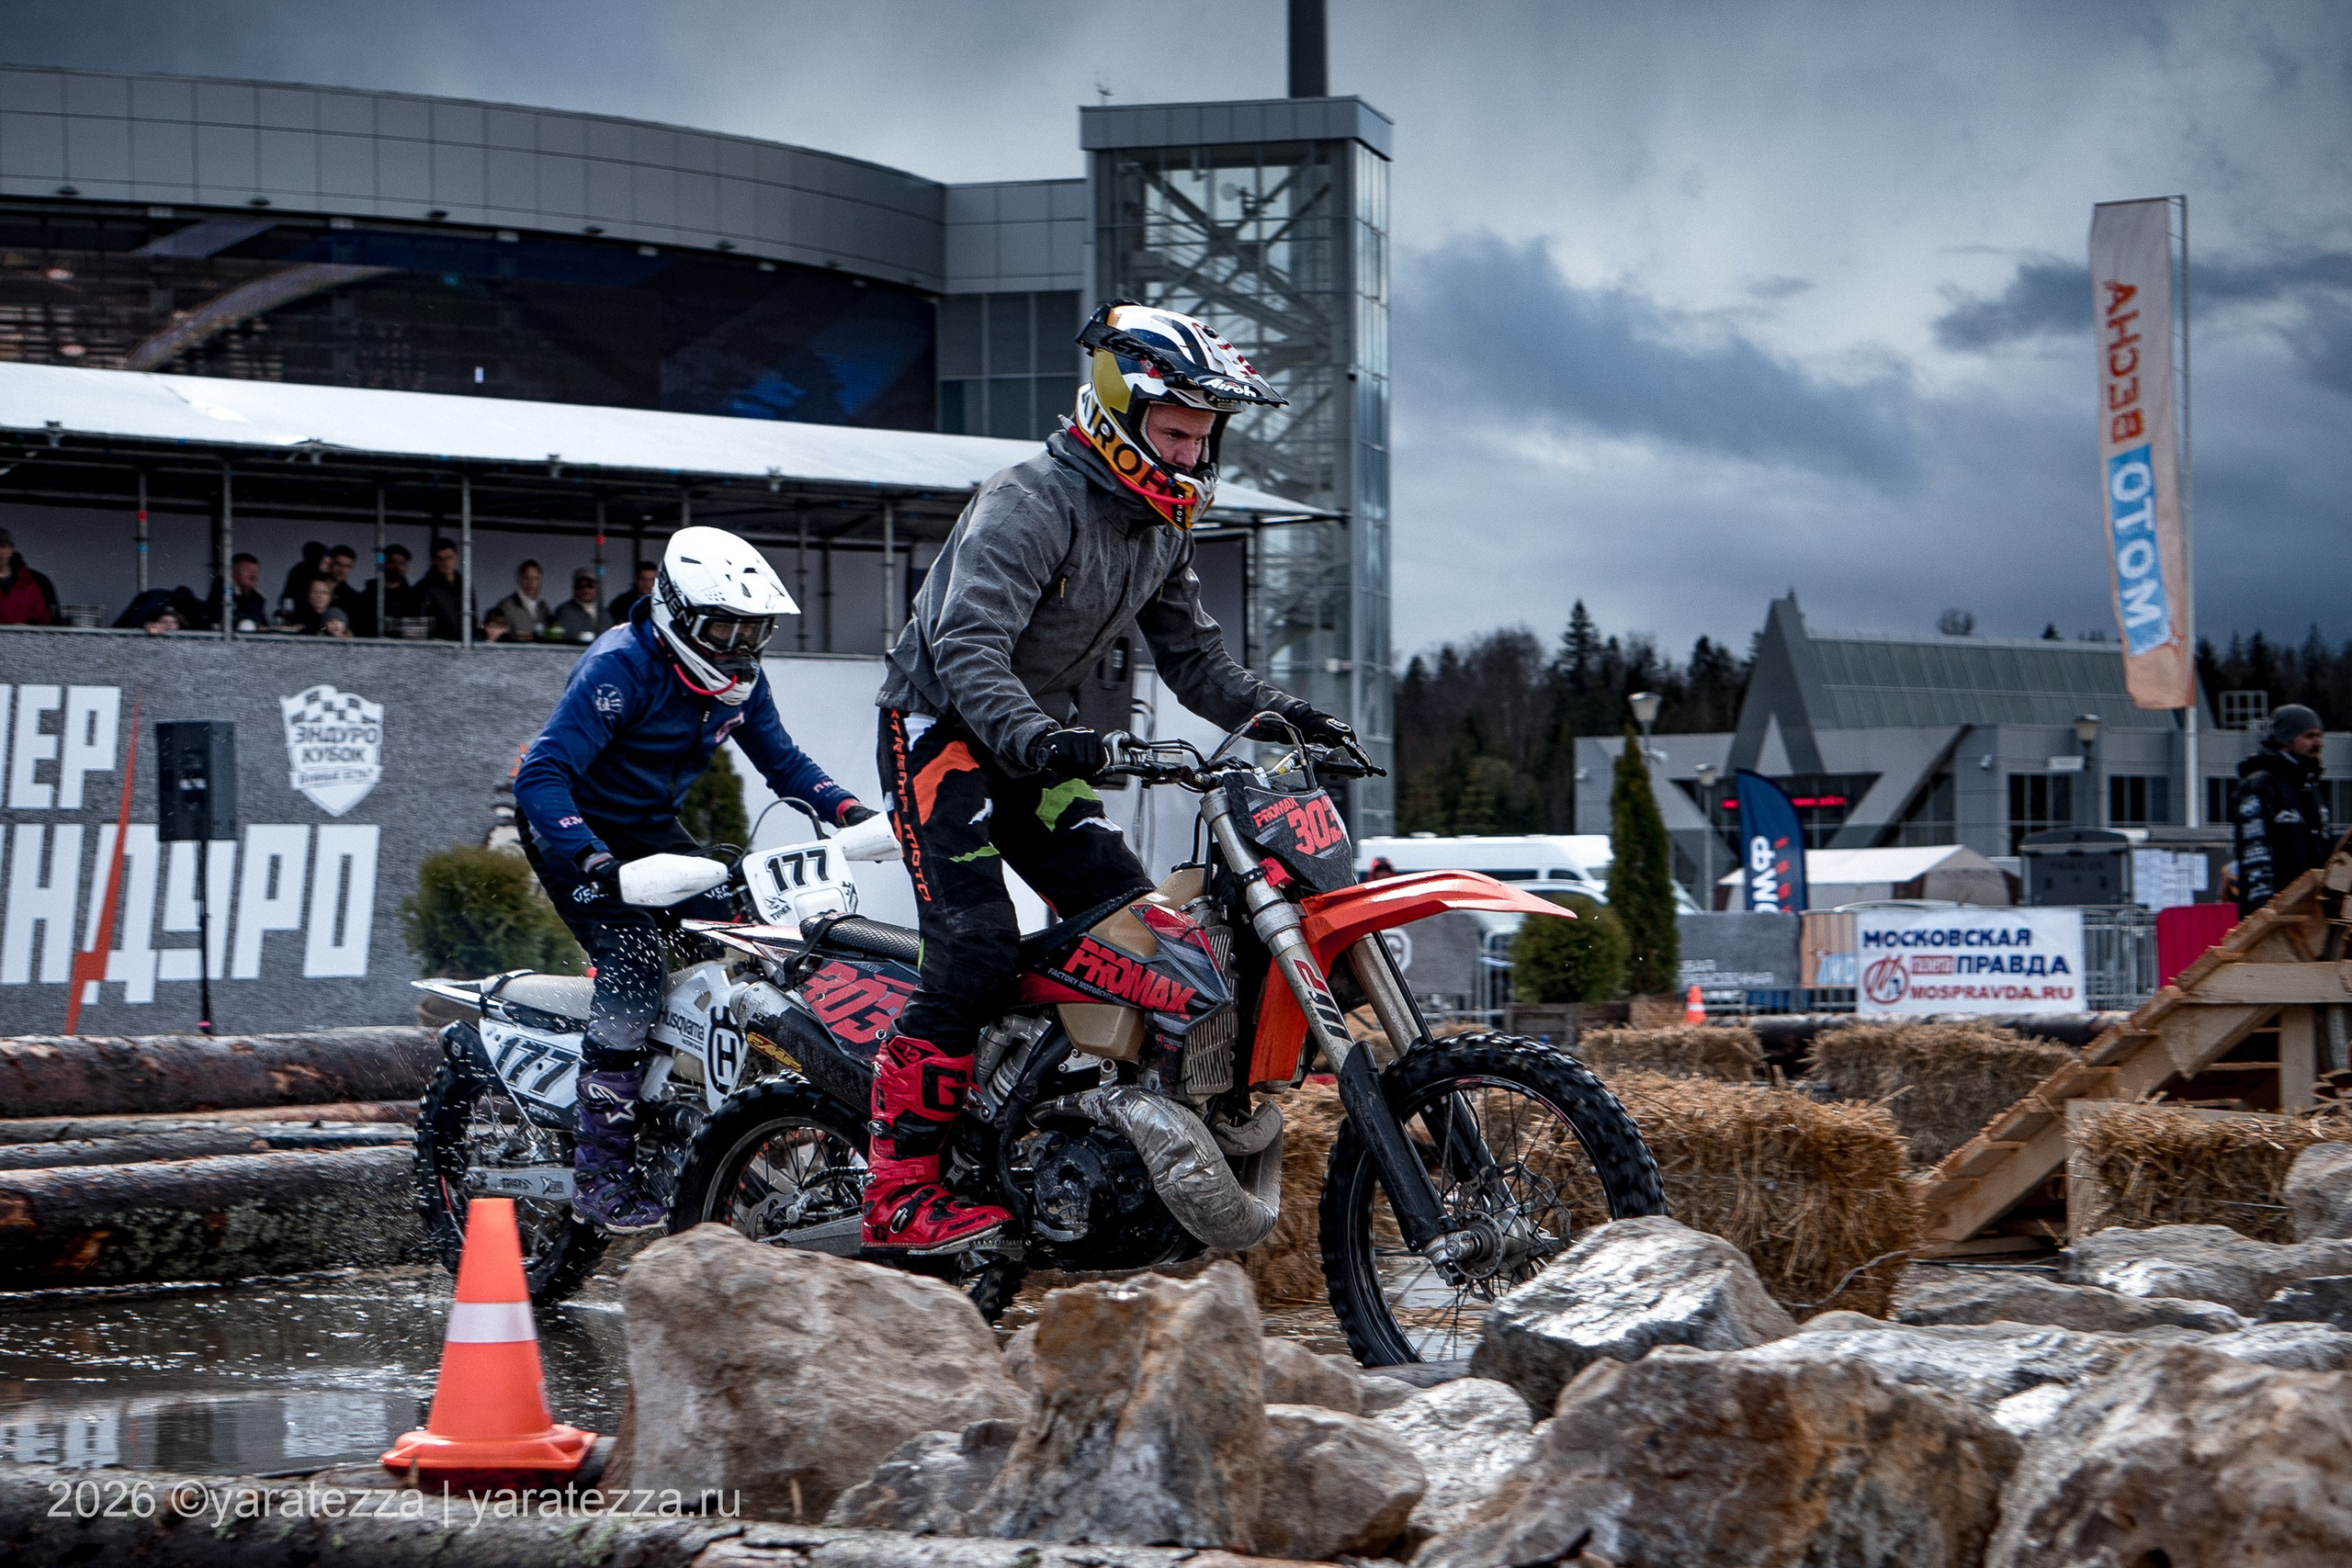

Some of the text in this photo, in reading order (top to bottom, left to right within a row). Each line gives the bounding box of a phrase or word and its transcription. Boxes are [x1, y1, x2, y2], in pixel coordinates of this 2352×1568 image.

[1202, 378, 1257, 398] Airoh
[0, 683, 121, 809] ЕР
[295, 726, 379, 743] ЭНДУРО
[301, 747, 366, 762] КУБОК
[1252, 797, 1300, 829] PROMAX
[1286, 795, 1346, 855] 303
[765, 847, 831, 895] 177
[0, 824, 379, 1003] НДУРО
[1863, 929, 2032, 947] МОСКОВСКАЯ
[1047, 967, 1079, 986] FACTORY
[1063, 936, 1196, 1021] PROMAX
[1956, 955, 2071, 976] ПРАВДА
[802, 961, 909, 1044] 303
[1910, 986, 2075, 1000] MOSPRAVDA.RU
[494, 1036, 581, 1096] 177
[746, 1032, 803, 1072] FMF
